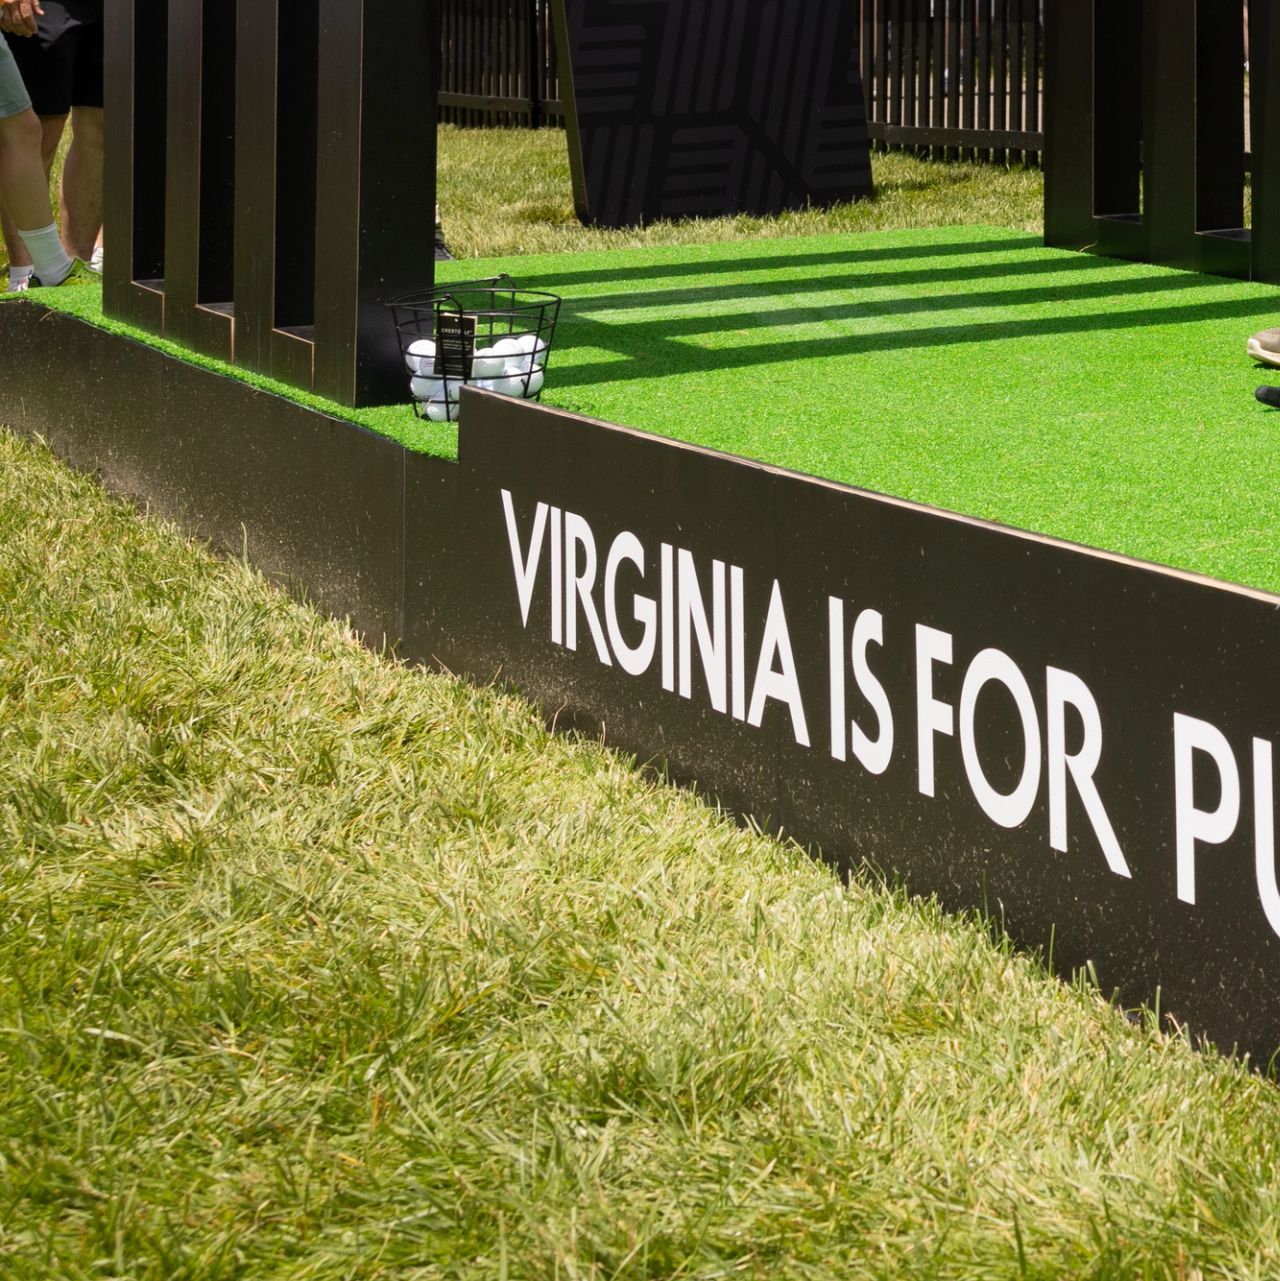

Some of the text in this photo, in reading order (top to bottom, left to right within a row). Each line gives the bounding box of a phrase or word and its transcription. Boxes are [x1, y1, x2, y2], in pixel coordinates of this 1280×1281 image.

[501, 488, 811, 748] VIRGINIA
[829, 596, 894, 775] IS
[915, 623, 1133, 879] FOR
